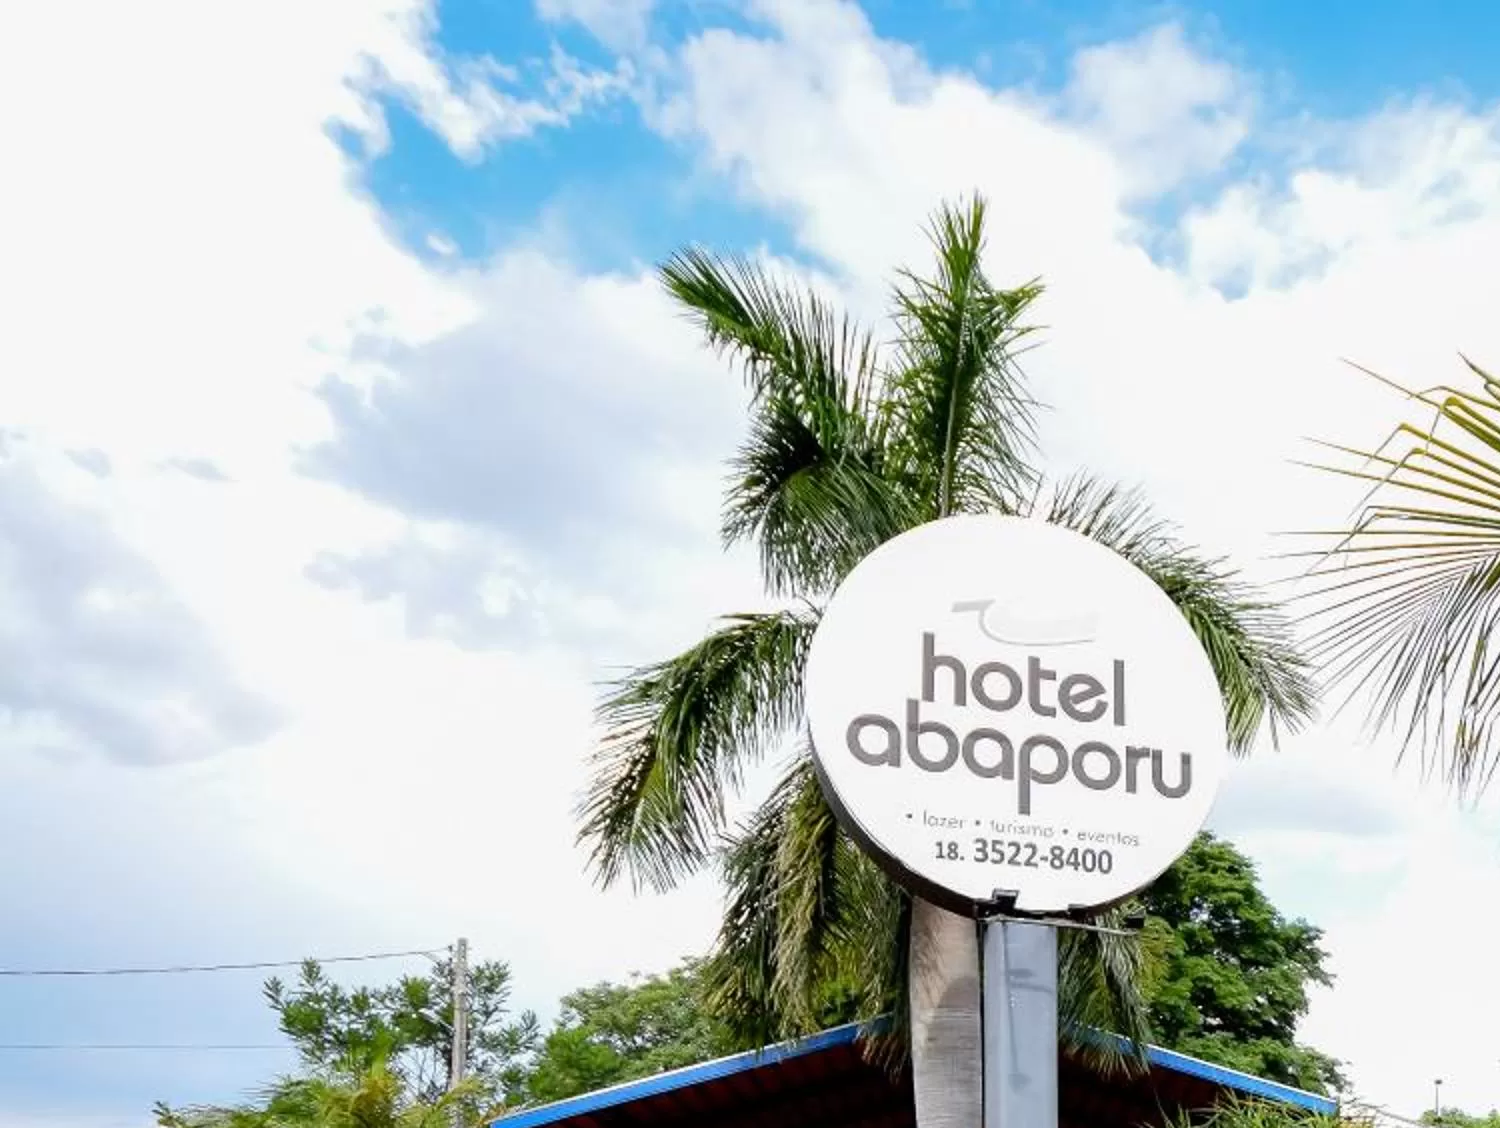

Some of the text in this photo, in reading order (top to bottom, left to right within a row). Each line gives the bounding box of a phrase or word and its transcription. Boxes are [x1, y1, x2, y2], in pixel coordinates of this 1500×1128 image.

[923, 631, 1126, 727] hotel
[845, 698, 1193, 816] abaporu
[922, 809, 1140, 847] lazer turismo eventos
[973, 838, 1114, 874] 3522-8400
